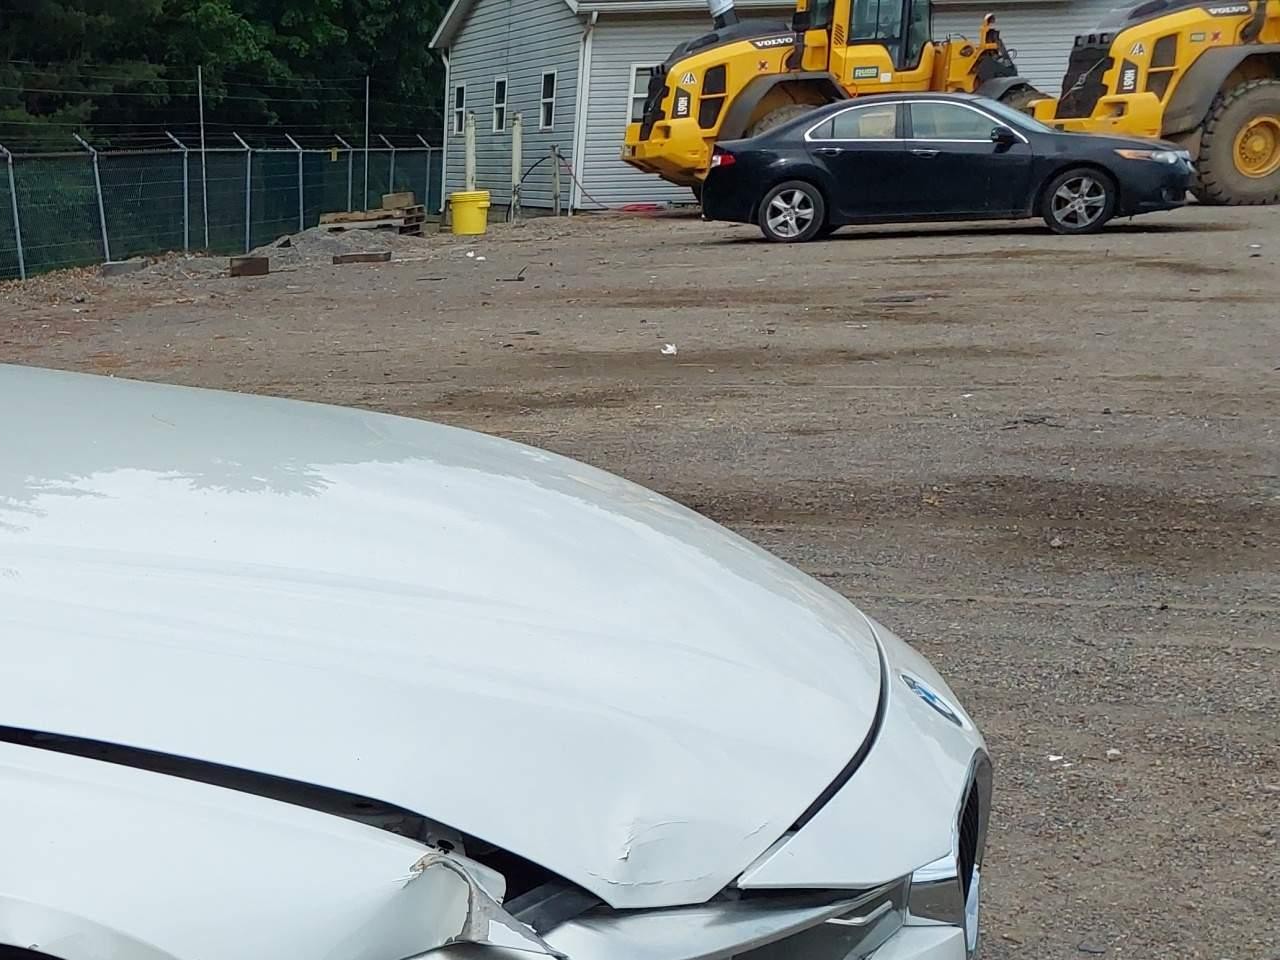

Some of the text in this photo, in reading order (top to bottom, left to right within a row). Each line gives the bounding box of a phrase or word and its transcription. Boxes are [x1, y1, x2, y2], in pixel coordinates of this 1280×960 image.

[1208, 5, 1249, 14] VOLVO
[755, 37, 793, 47] VOLVO
[1123, 69, 1136, 90] L90H
[677, 97, 688, 115] L90H
